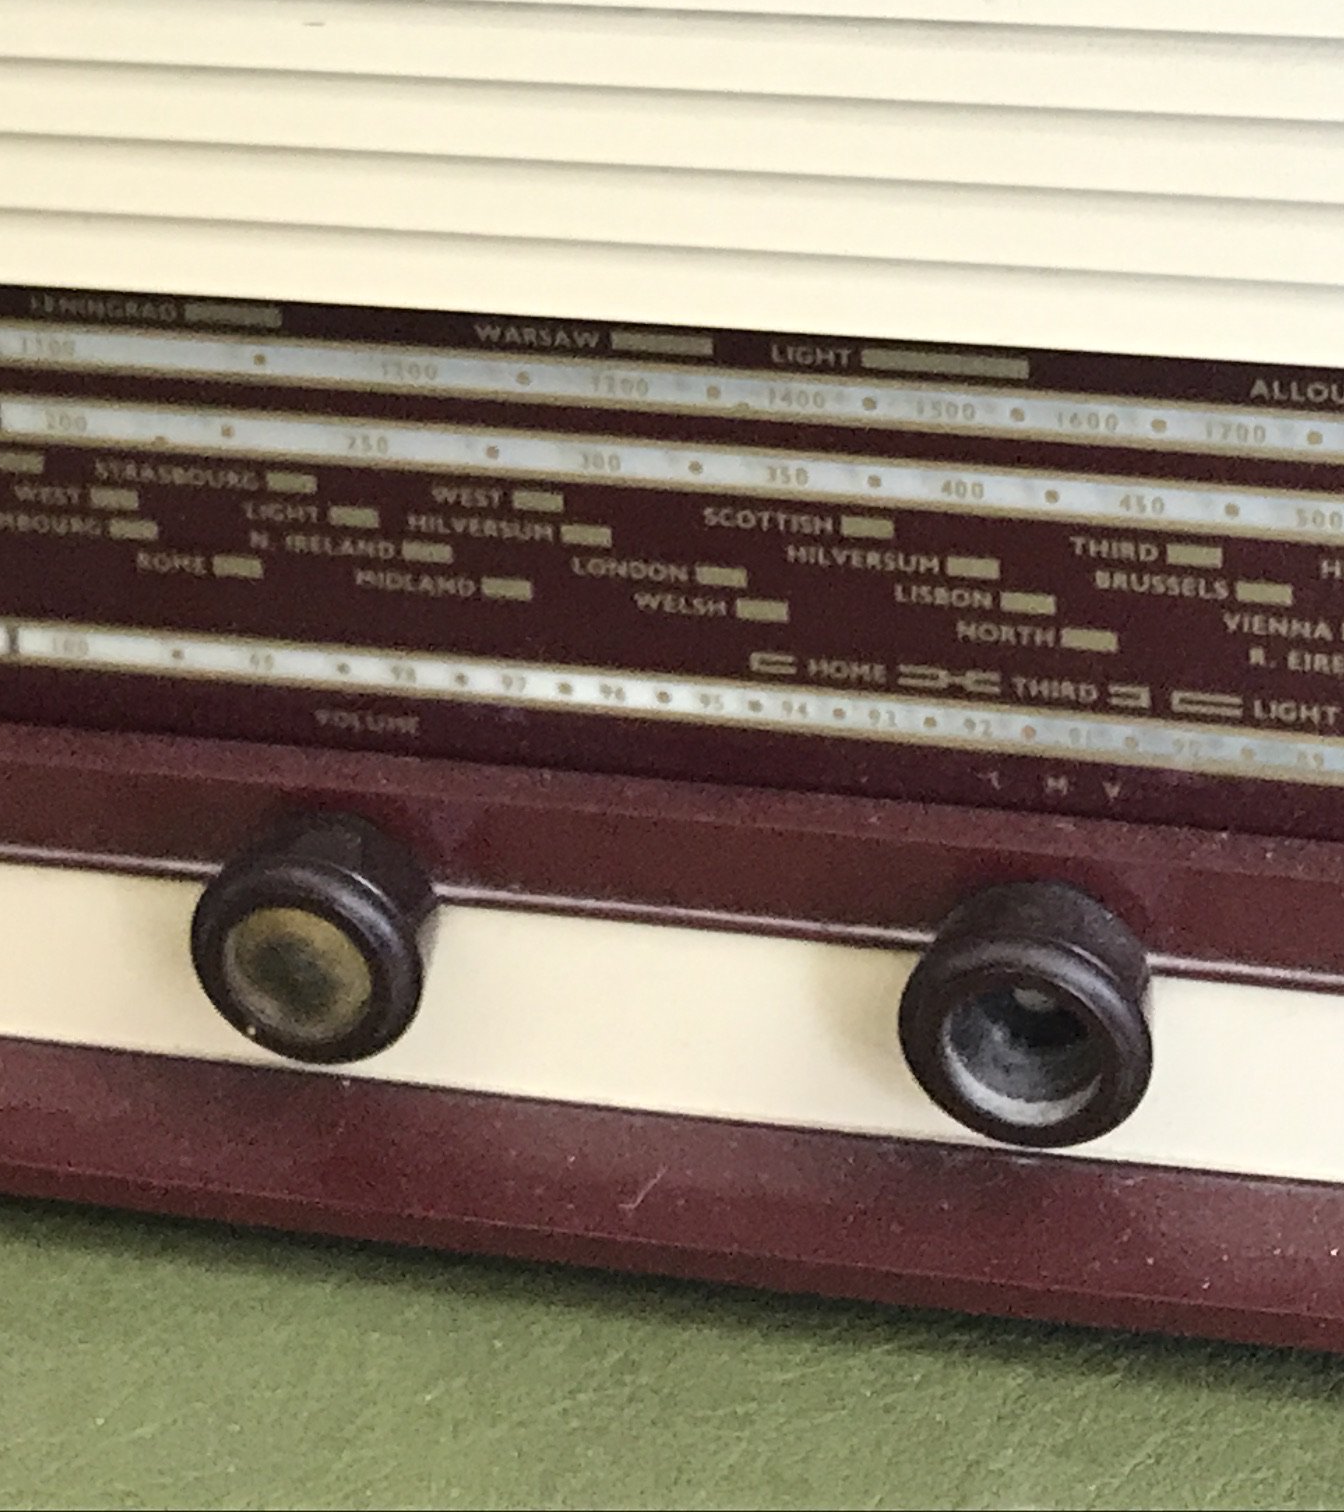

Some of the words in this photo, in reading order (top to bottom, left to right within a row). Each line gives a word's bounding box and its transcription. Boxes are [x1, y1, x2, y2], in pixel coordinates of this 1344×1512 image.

[473, 322, 600, 349] WARSAW
[770, 343, 853, 368] LIGHT
[767, 389, 826, 411] 1400
[914, 400, 976, 422] 1500
[1056, 410, 1119, 433] 1600
[1206, 421, 1267, 444] 1700
[431, 485, 502, 509] WEST
[767, 466, 809, 487] 350
[941, 479, 984, 500] 400
[1119, 493, 1165, 515] 450
[1296, 507, 1344, 530] 500
[245, 501, 320, 526] LIGHT
[407, 513, 554, 542] HILVERSUM
[702, 506, 833, 536] SCOTTISH
[285, 533, 396, 561] IRELAND
[787, 543, 940, 575] HILVERSUM
[1069, 535, 1158, 563] THIRD
[356, 568, 476, 598] MIDLAND
[570, 555, 689, 584] LONDON
[894, 583, 994, 610] LISBON
[1095, 569, 1230, 601] BRUSSELS
[633, 591, 728, 618] WELSH
[956, 621, 1055, 648] NORTH
[1222, 611, 1334, 642] VIENNA
[807, 656, 887, 683] HOME
[1012, 677, 1099, 704] THIRD
[782, 700, 809, 720] 94
[963, 717, 994, 738] 92
[1253, 698, 1341, 725] LIGHT
